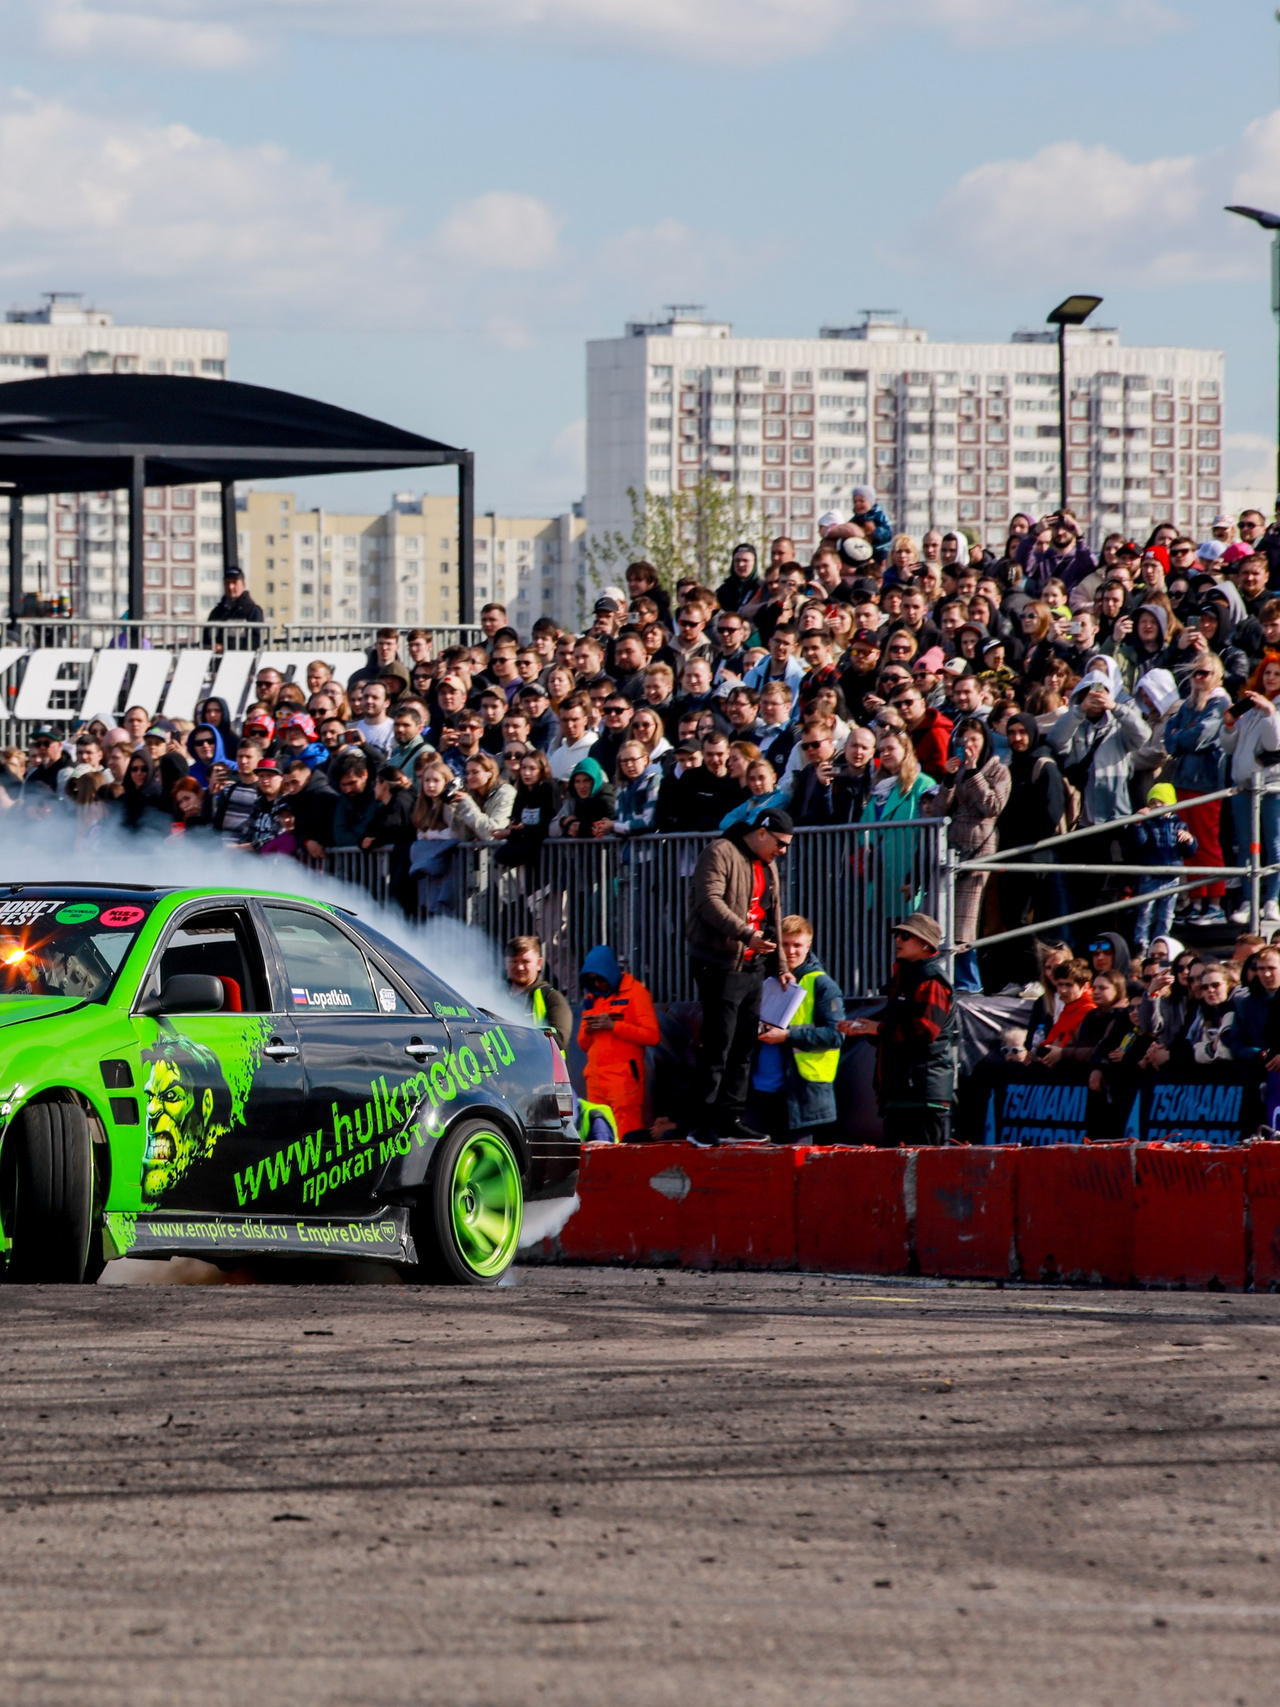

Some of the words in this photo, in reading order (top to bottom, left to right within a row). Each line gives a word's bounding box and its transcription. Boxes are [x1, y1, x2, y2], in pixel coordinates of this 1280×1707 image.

[2, 901, 66, 913] DRIFT
[305, 988, 352, 1010] Lopatkin
[234, 1025, 517, 1207] www.hulkmoto.ru
[1002, 1083, 1089, 1122] TSUNAMI
[1148, 1084, 1244, 1122] TSUNAMI
[148, 1218, 288, 1243] www.empire-disk.ru
